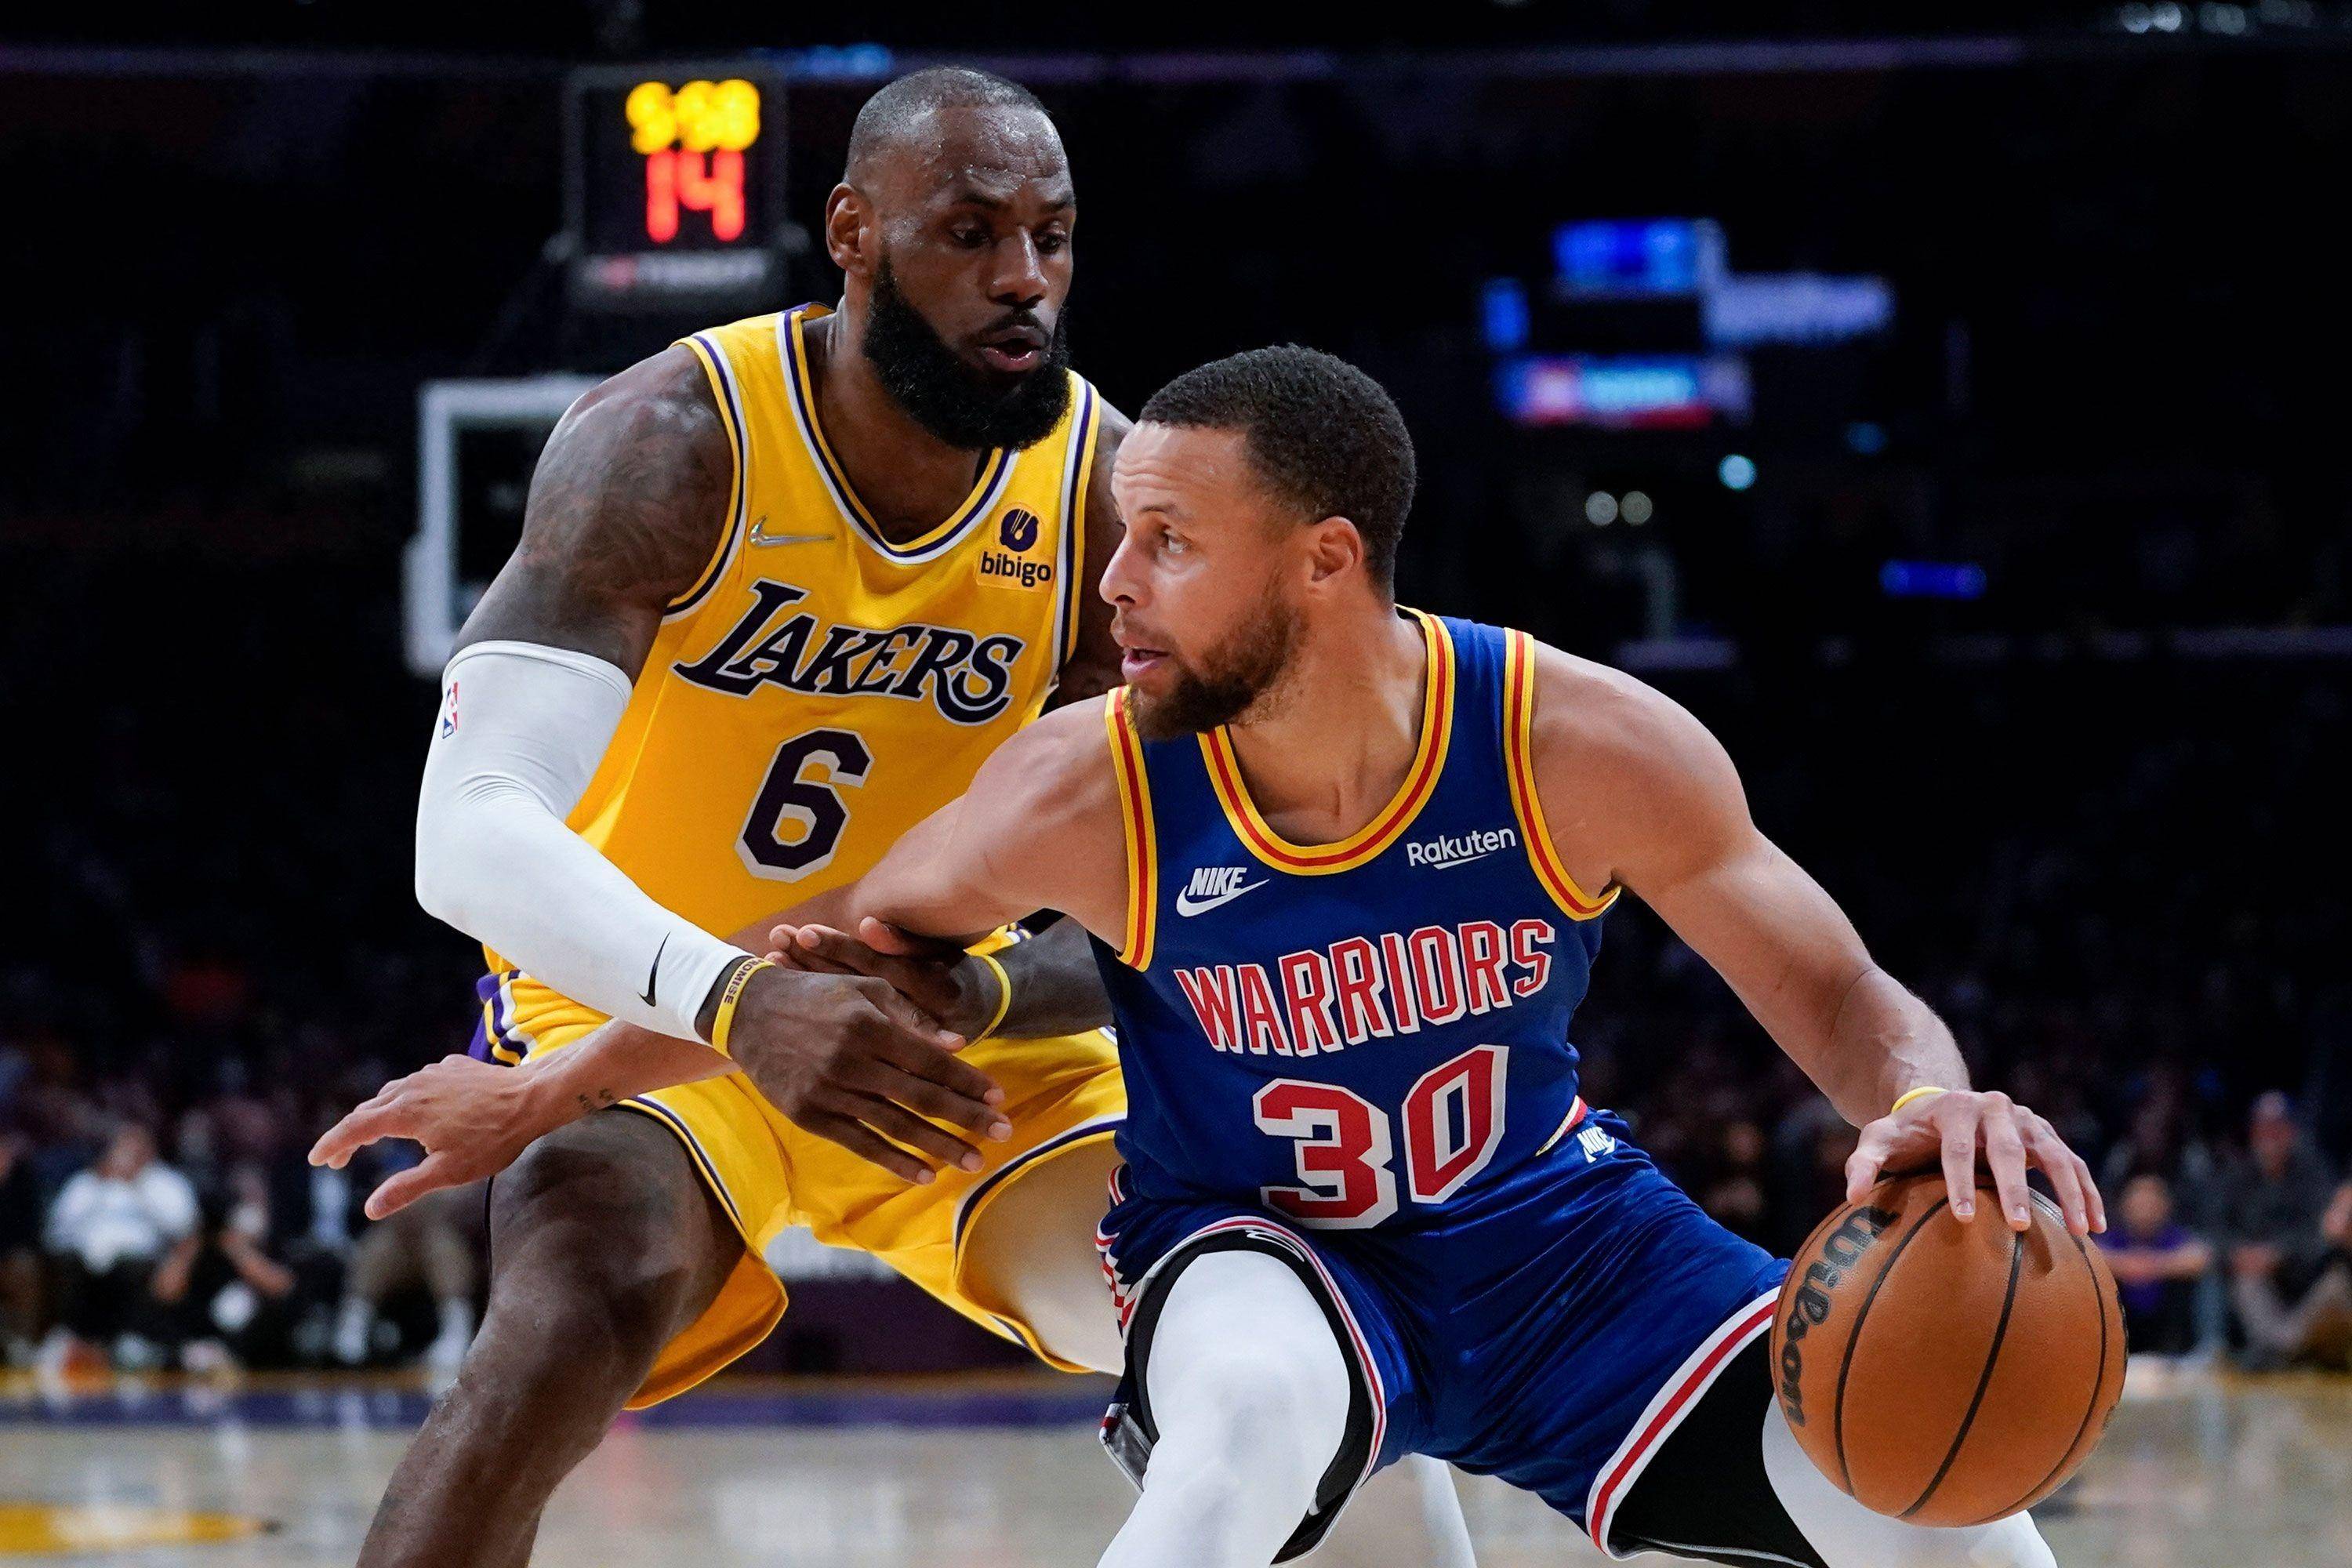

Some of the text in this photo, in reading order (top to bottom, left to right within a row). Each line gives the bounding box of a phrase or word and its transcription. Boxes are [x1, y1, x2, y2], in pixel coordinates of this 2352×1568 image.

[645, 147, 745, 243] 14
[981, 551, 1051, 587] bibigo
[670, 577, 1026, 725] LAKERS
[734, 727, 875, 884] 6
[1406, 828, 1516, 867] Rakuten
[1186, 867, 1248, 896] NIKE
[1174, 919, 1555, 1057] WARRIORS
[1253, 1044, 1510, 1230] 30
[1782, 1205, 1901, 1427] Wilson
